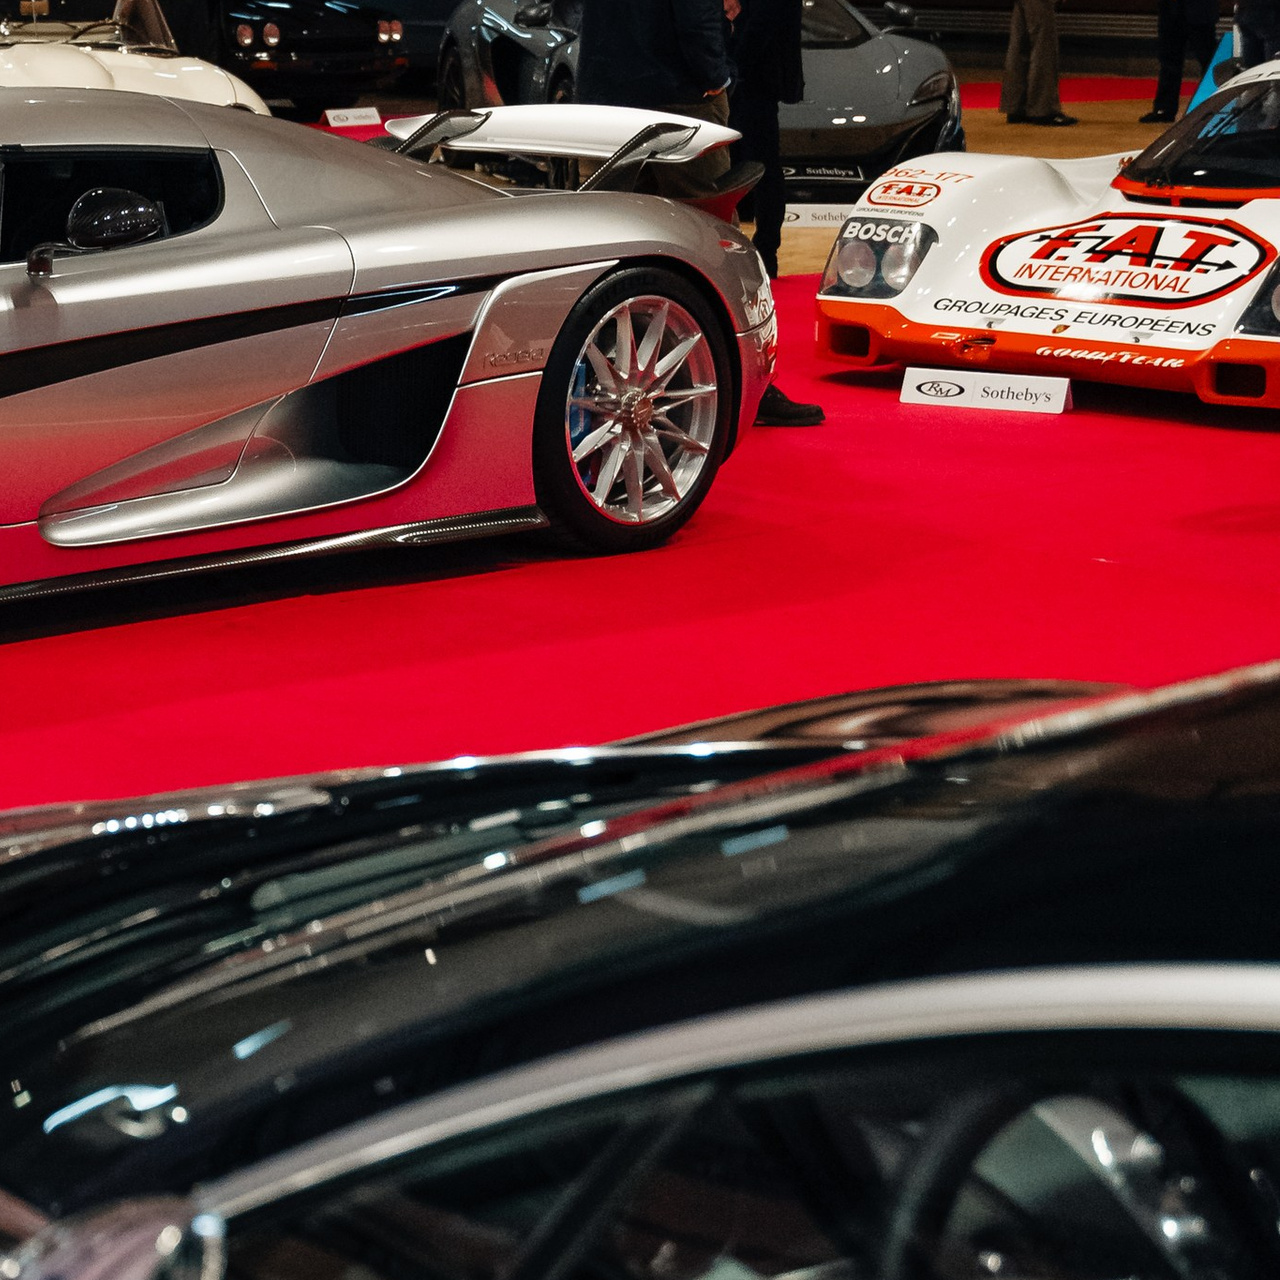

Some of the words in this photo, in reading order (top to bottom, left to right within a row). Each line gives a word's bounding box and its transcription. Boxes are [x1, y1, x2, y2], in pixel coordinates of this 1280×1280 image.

[876, 195, 921, 203] INTERNATIONAL
[842, 221, 921, 244] BOSCH
[1013, 263, 1193, 294] INTERNATIONAL
[932, 297, 1069, 321] GROUPAGES
[1071, 310, 1218, 338] EUROPÉENS
[980, 386, 1052, 405] Sotheby's
